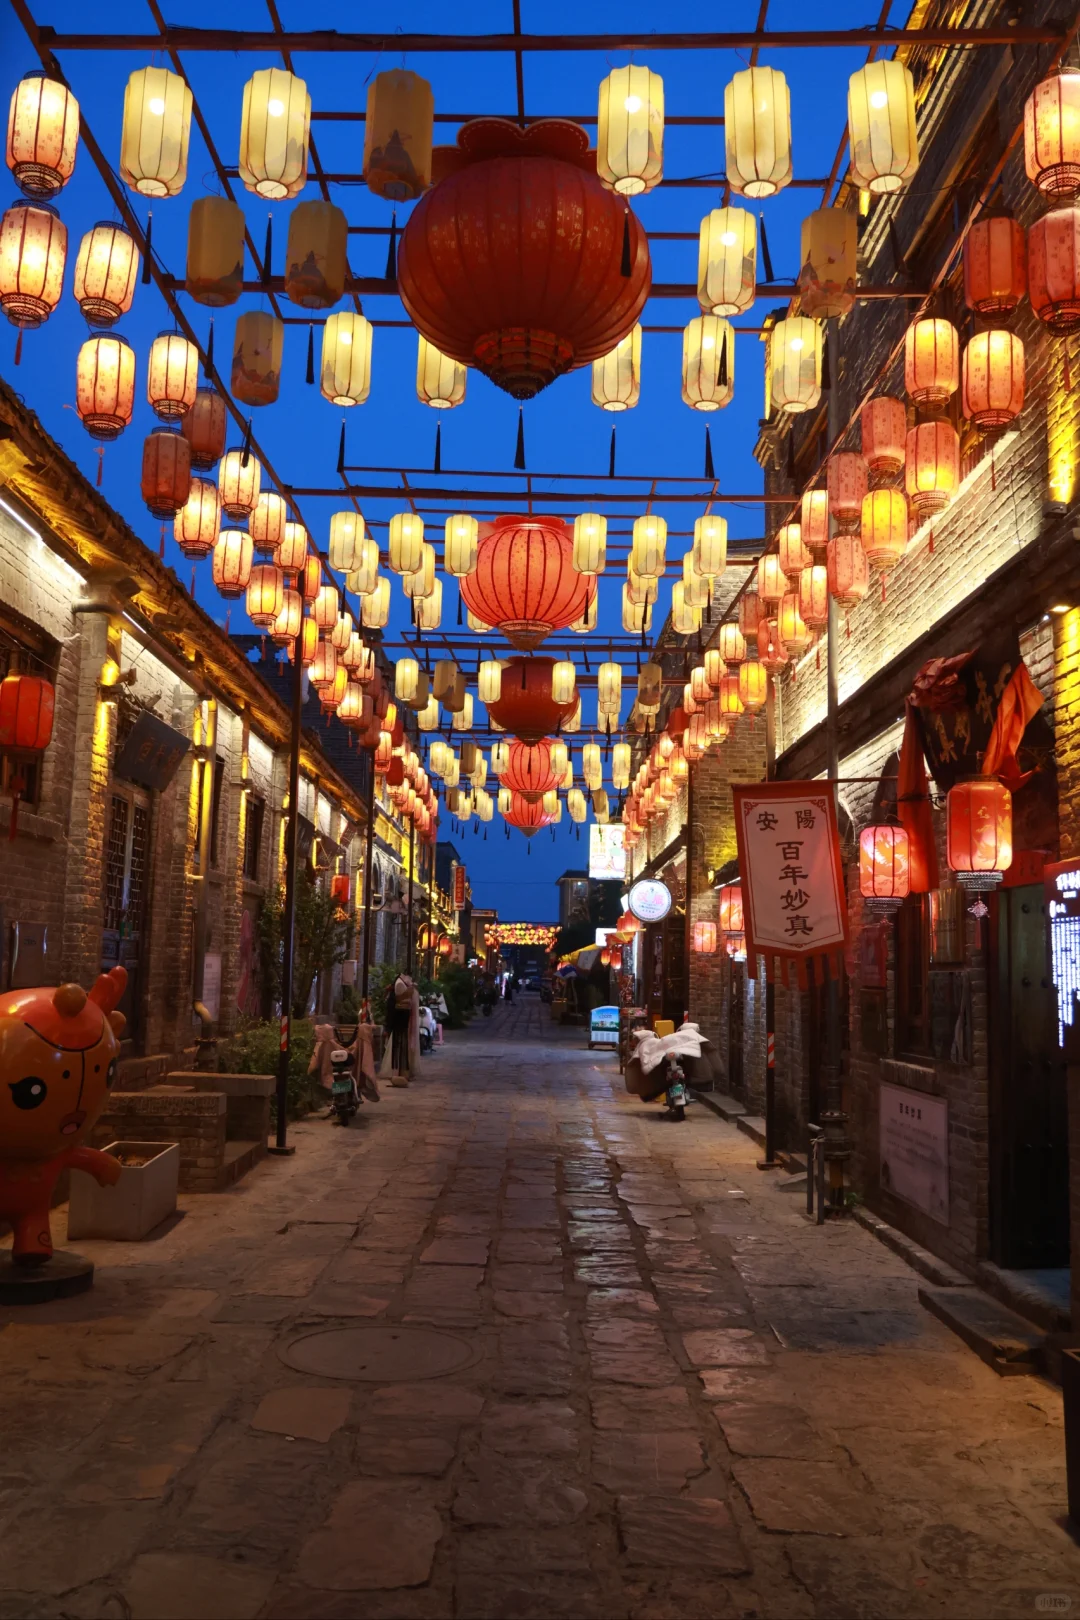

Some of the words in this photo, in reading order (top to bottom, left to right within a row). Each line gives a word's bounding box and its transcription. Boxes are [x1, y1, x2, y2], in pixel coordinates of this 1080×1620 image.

[756, 809, 817, 832] 安陽
[775, 840, 814, 937] 百年妙真
